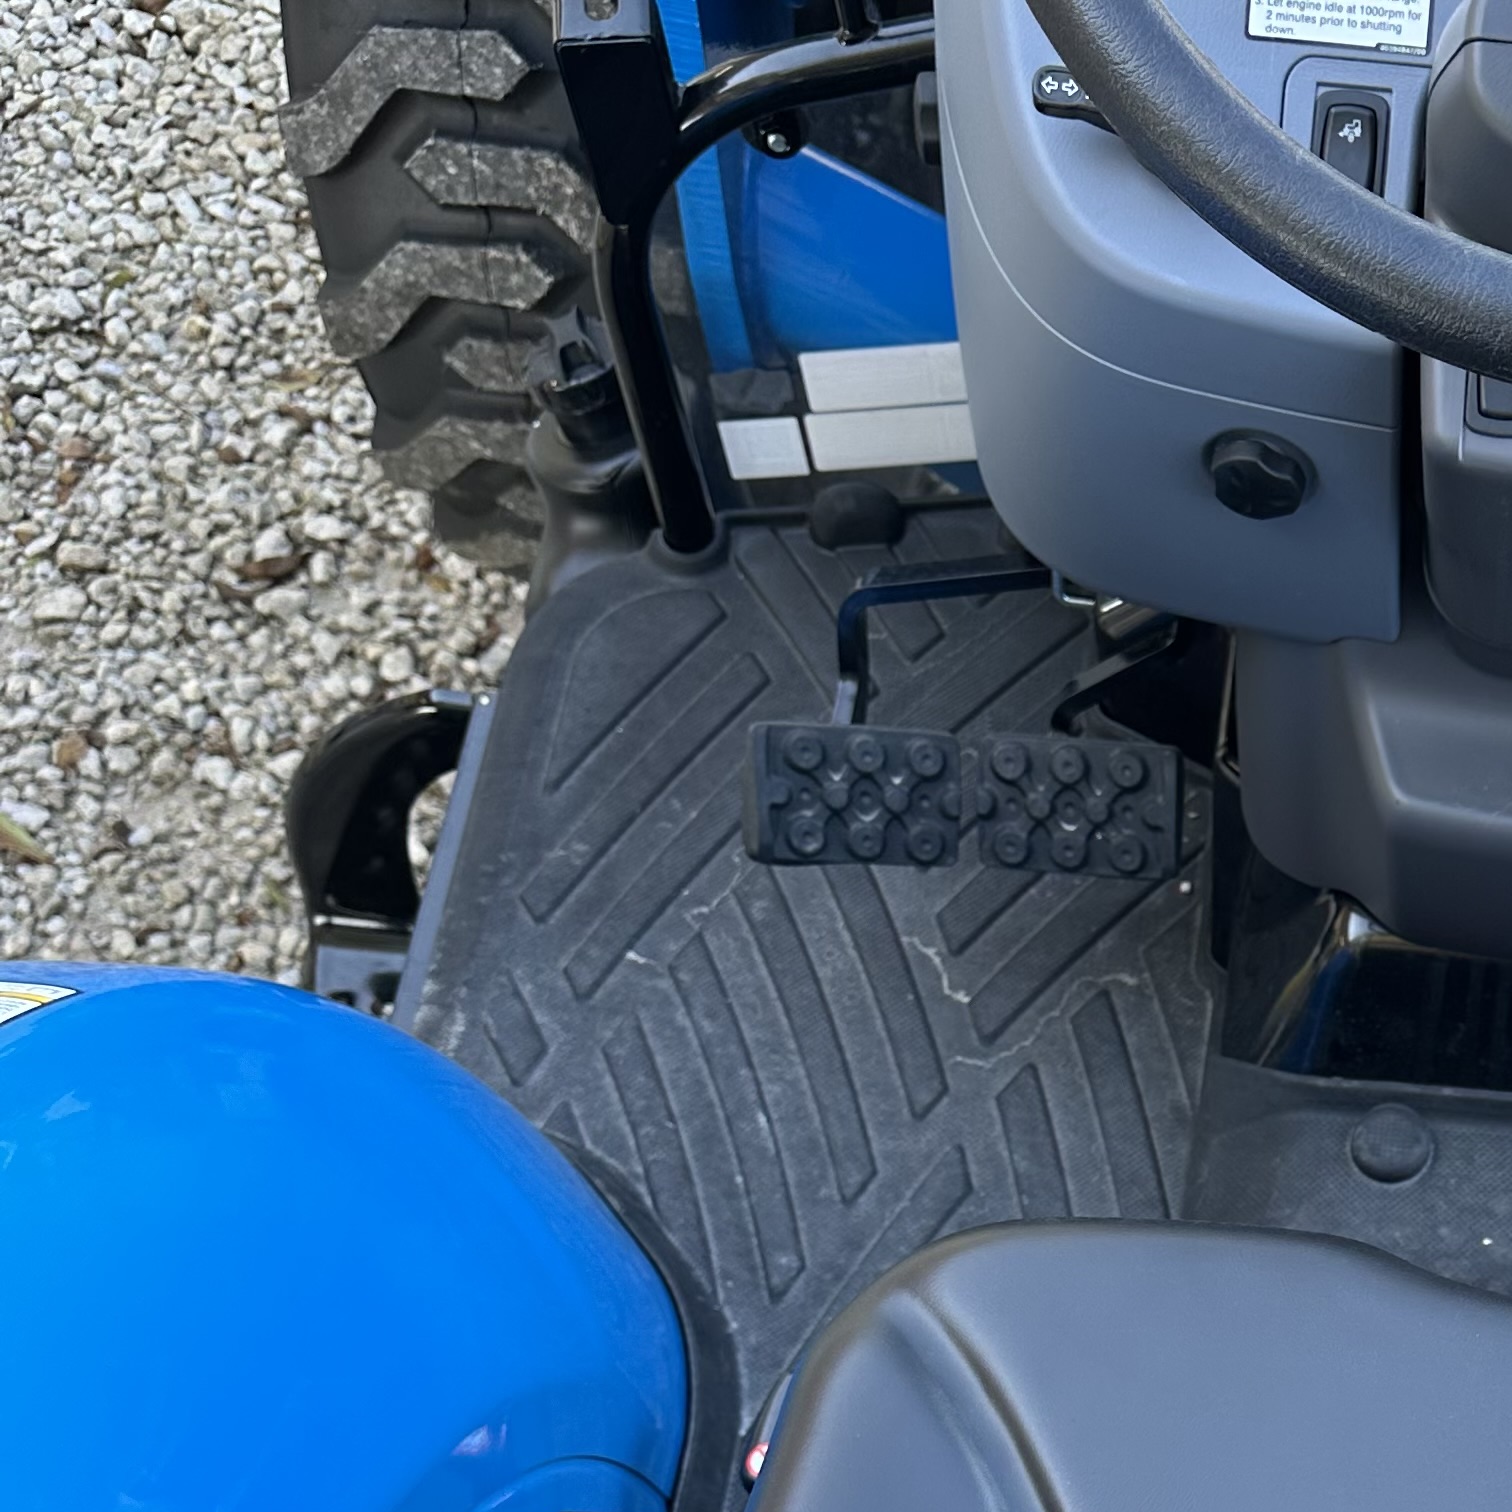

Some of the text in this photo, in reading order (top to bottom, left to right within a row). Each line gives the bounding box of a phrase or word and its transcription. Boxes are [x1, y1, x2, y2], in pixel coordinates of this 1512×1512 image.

[1286, 0, 1322, 11] engine
[1324, 2, 1344, 13] idle
[1346, 5, 1357, 14] at
[1360, 6, 1405, 20] 1000rpm
[1408, 10, 1422, 20] for
[1266, 10, 1403, 35] 2 minutes prior to shutting
